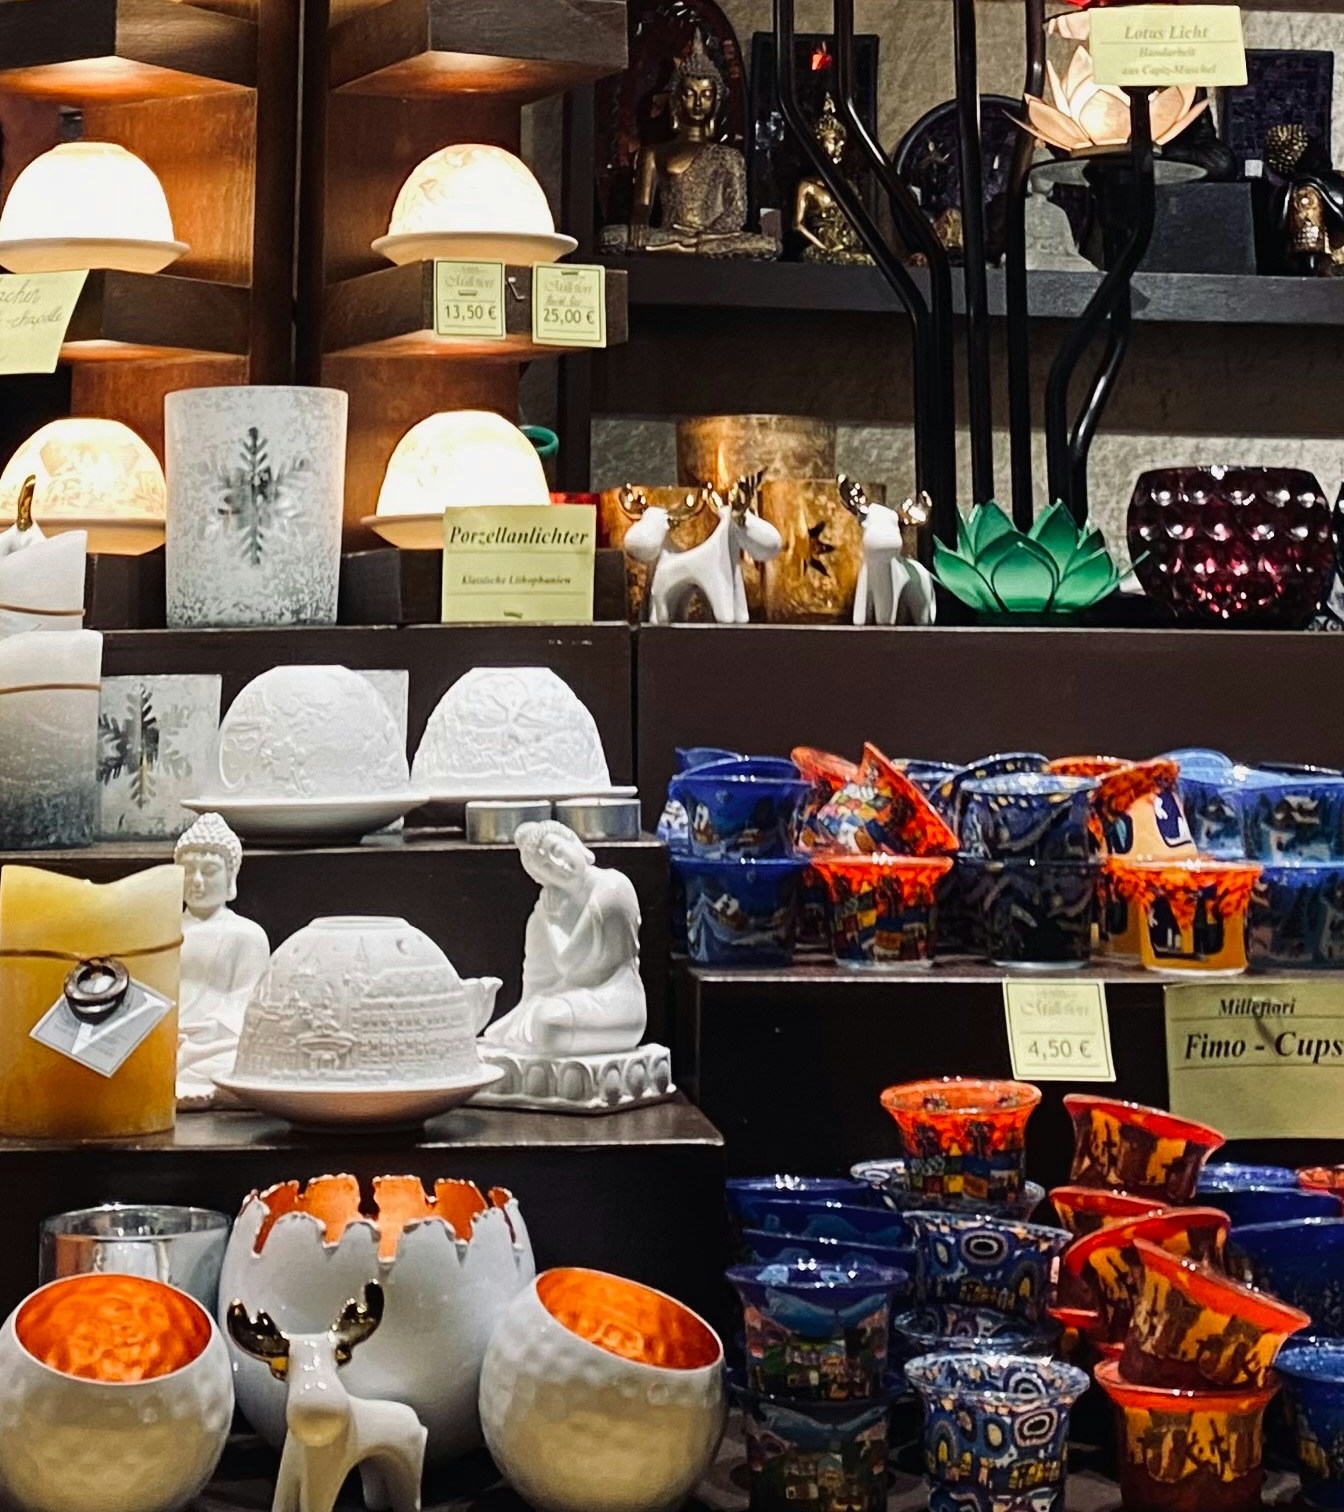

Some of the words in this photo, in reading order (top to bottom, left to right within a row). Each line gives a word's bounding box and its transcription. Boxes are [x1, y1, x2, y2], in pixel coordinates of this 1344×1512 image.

[1124, 25, 1164, 40] Lotus
[1169, 25, 1209, 40] Licht
[444, 304, 484, 321] 13,50
[488, 305, 497, 320] €
[543, 308, 582, 325] 25,00
[587, 310, 595, 325] €
[449, 526, 589, 546] Porzellanlichter
[1218, 997, 1297, 1018] Millefiori
[1028, 1039, 1072, 1061] 4,50
[1079, 1039, 1092, 1059] €
[1185, 1032, 1247, 1060] Fimo
[1274, 1031, 1344, 1064] Cups
